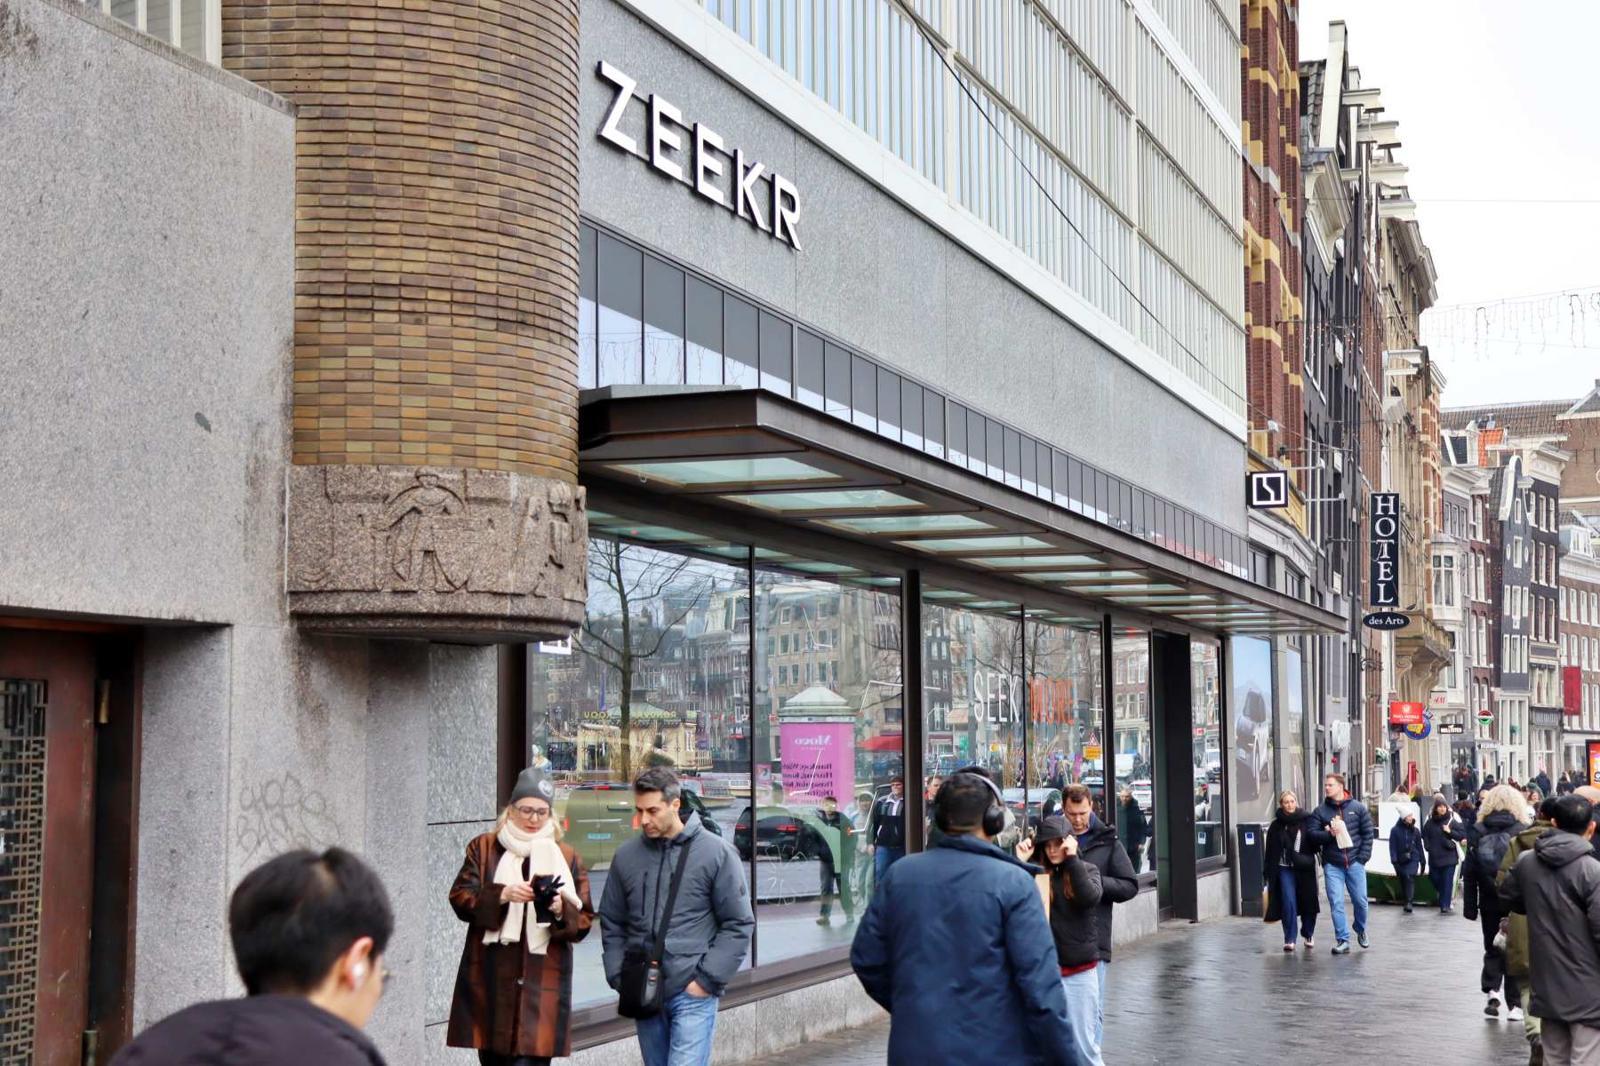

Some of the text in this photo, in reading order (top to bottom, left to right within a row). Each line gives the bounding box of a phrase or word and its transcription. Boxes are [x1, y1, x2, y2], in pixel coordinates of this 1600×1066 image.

[597, 60, 802, 251] ZEEKR
[1374, 495, 1396, 603] HOTEL
[1368, 617, 1405, 625] des Arts
[973, 670, 1075, 725] SEEK MORE
